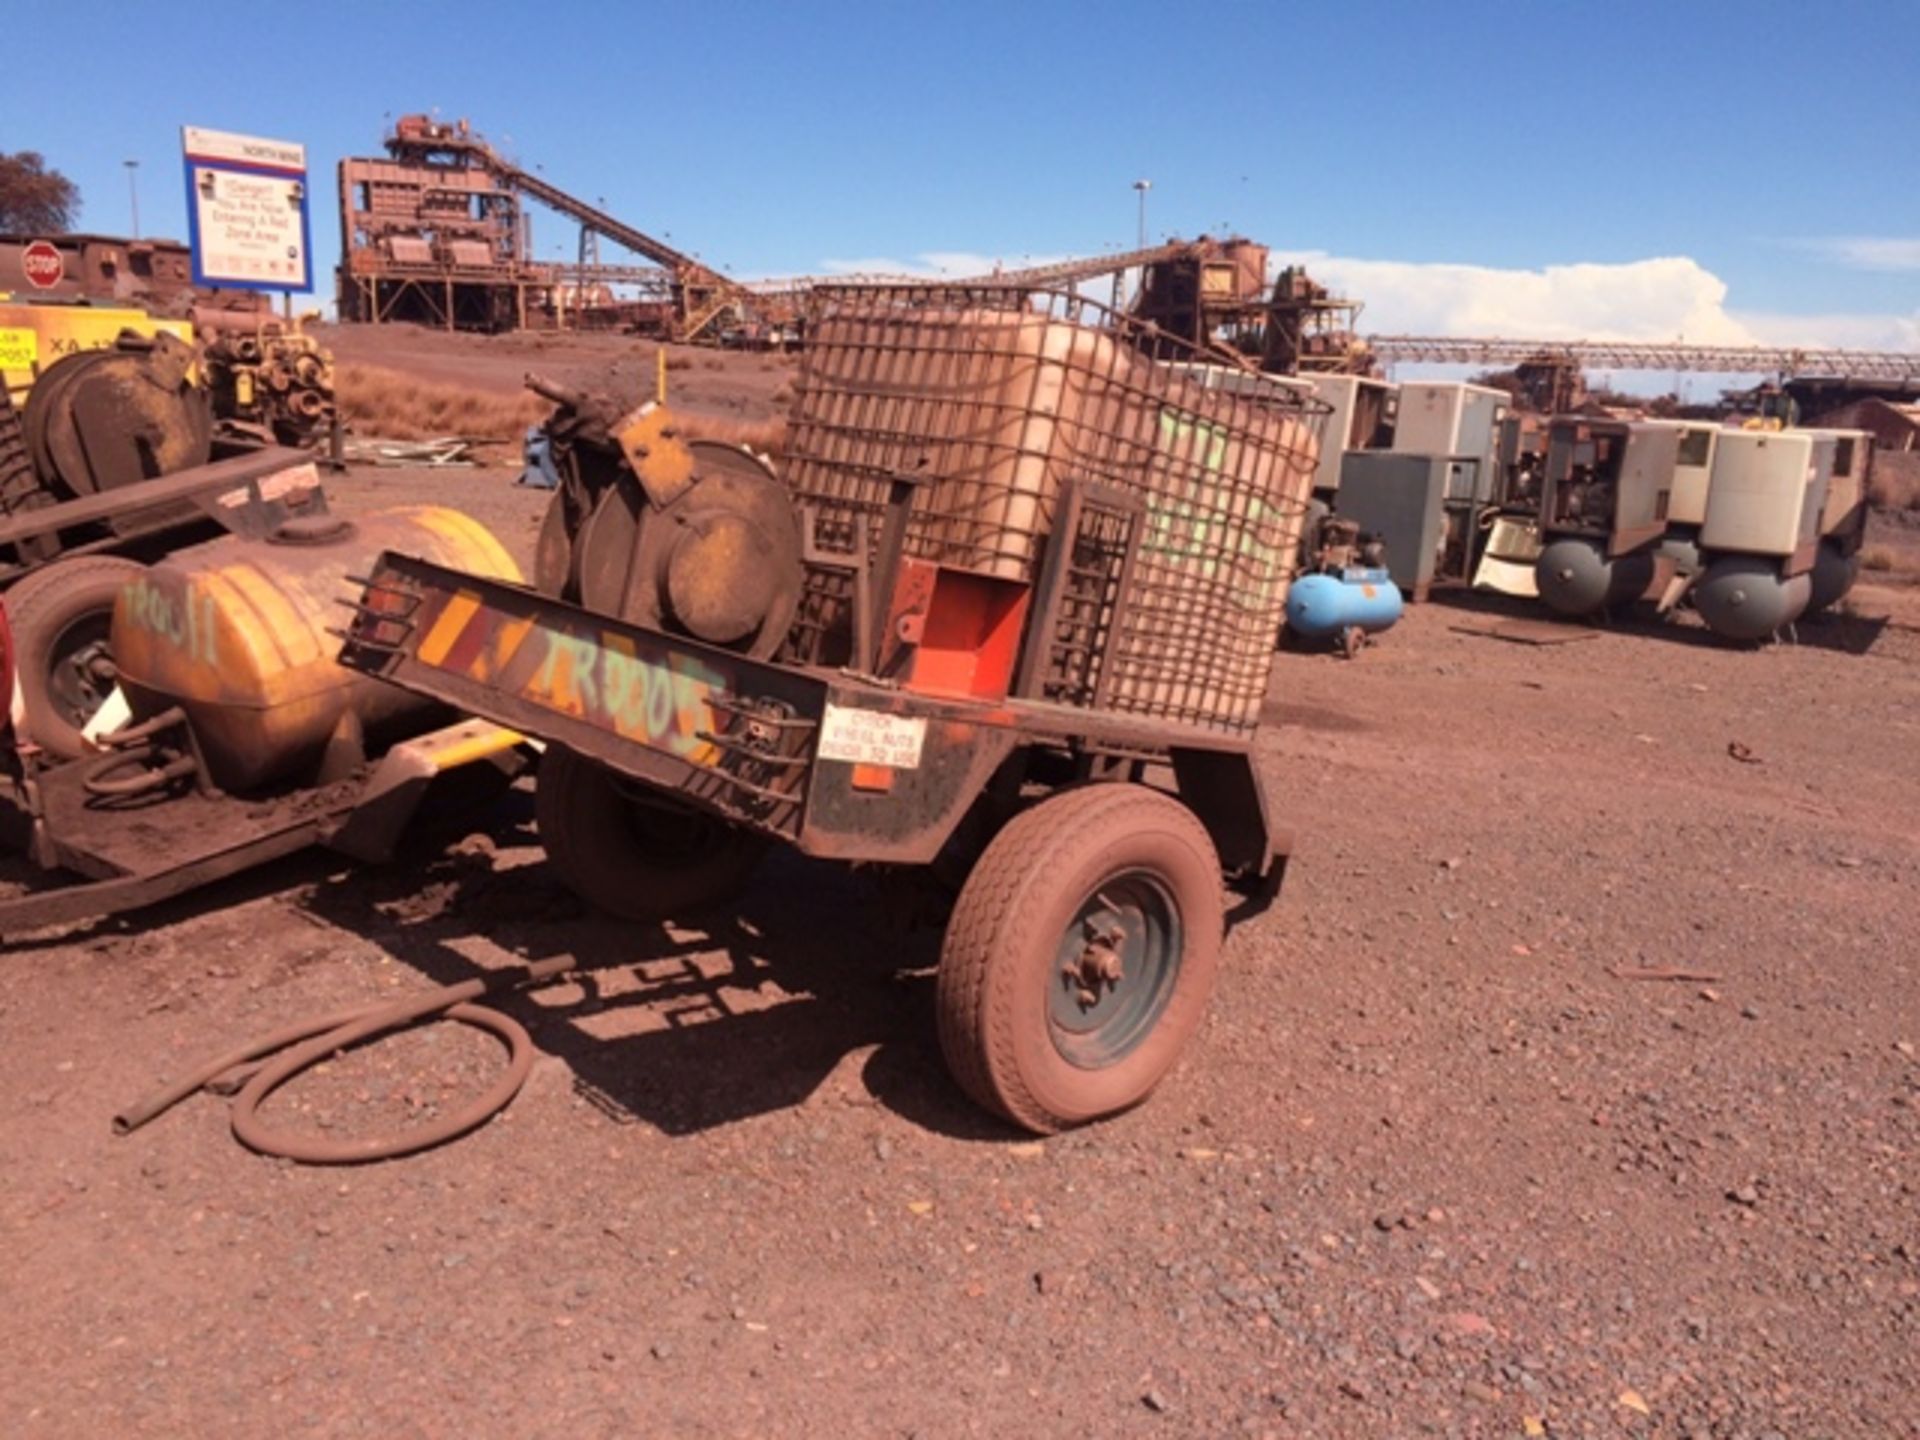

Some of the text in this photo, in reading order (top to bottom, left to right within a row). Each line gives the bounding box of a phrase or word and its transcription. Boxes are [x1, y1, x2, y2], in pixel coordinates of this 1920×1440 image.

[212, 209, 256, 229] Entering
[225, 225, 280, 243] Zone Area
[26, 253, 58, 274] STOP
